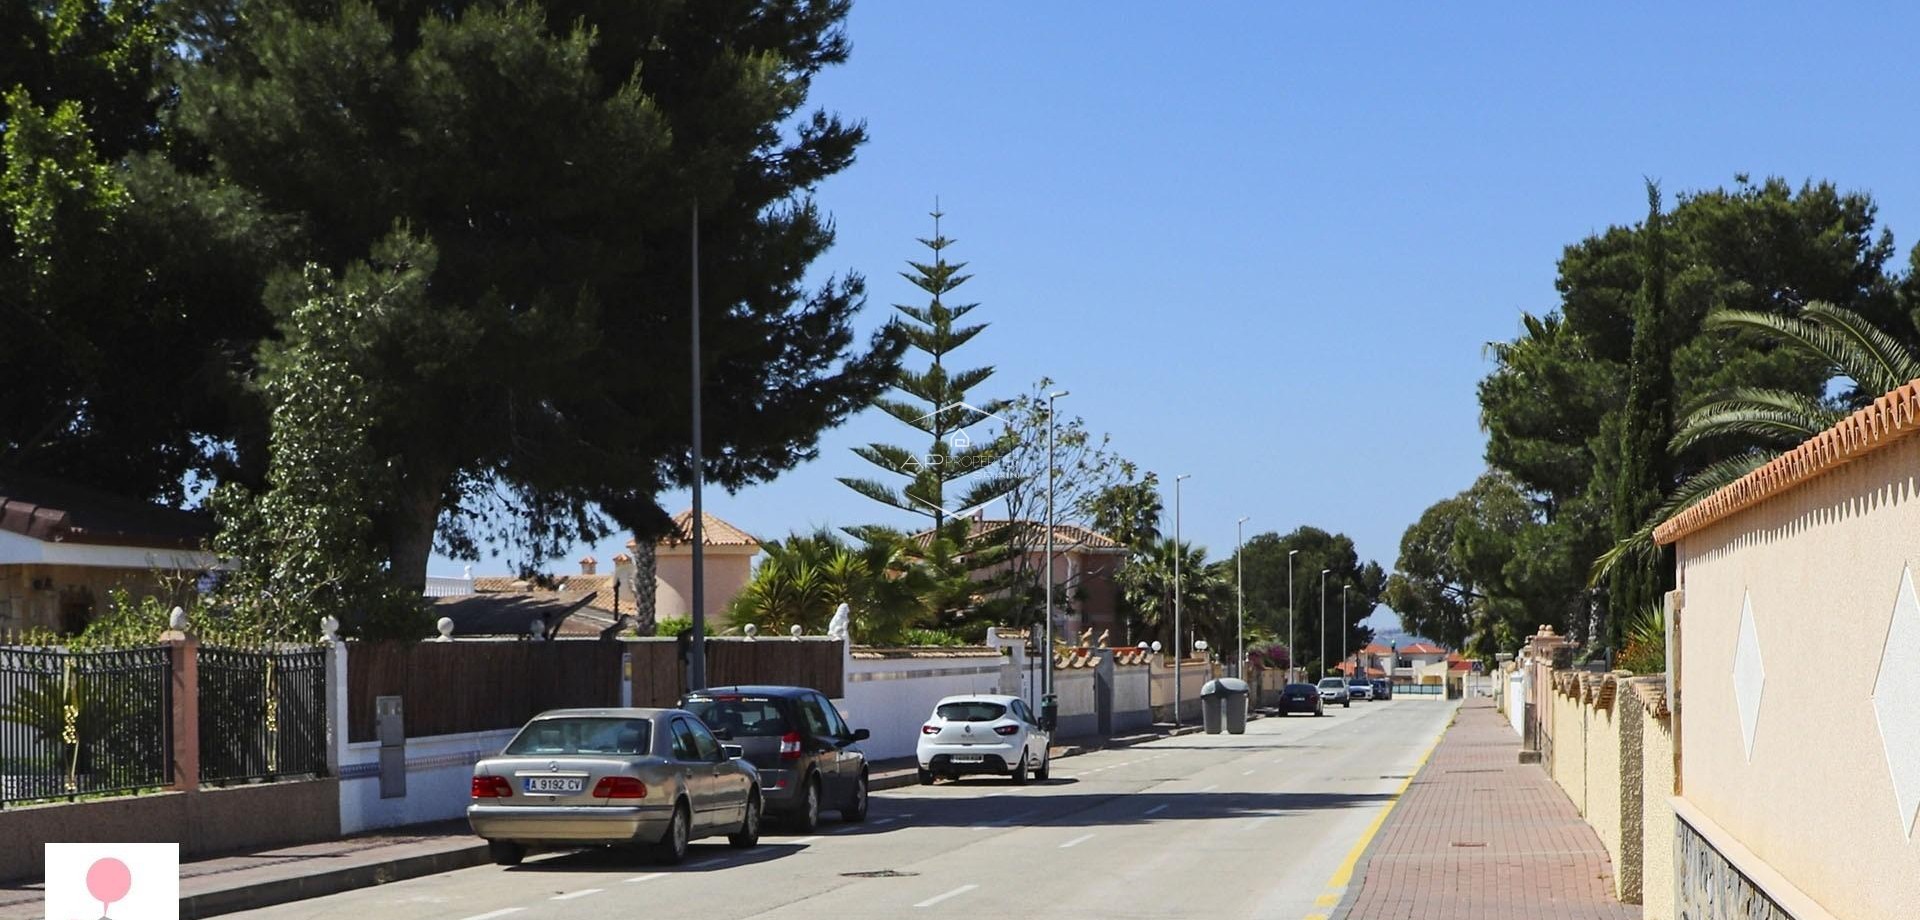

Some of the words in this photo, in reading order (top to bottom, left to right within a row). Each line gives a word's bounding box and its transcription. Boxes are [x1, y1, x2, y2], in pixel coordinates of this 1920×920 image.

[531, 780, 537, 789] A
[540, 779, 565, 790] 9192
[568, 779, 582, 790] CV
